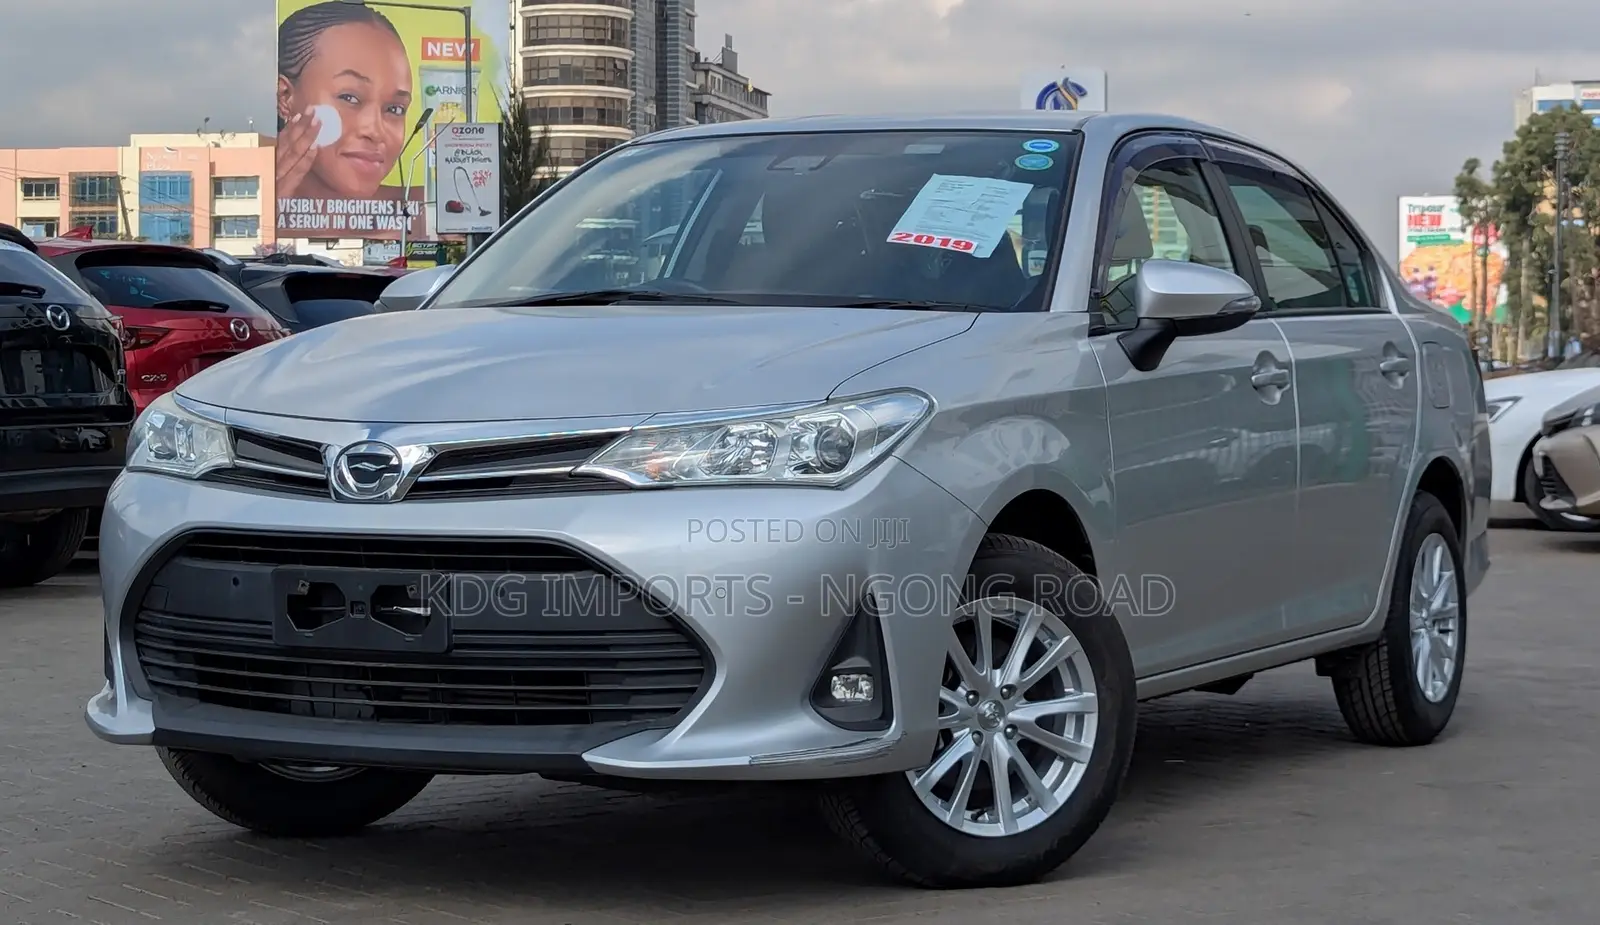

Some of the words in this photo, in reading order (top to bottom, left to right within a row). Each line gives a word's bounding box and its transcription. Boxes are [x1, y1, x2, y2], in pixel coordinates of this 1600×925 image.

[427, 41, 476, 58] NEW
[277, 199, 324, 214] VISIBLY
[327, 199, 395, 215] BRIGHTENS
[277, 215, 287, 229] A
[289, 215, 330, 229] SERUM
[333, 215, 346, 229] IN
[349, 215, 374, 230] ONE
[1407, 213, 1442, 227] NEW
[891, 232, 973, 250] 2019
